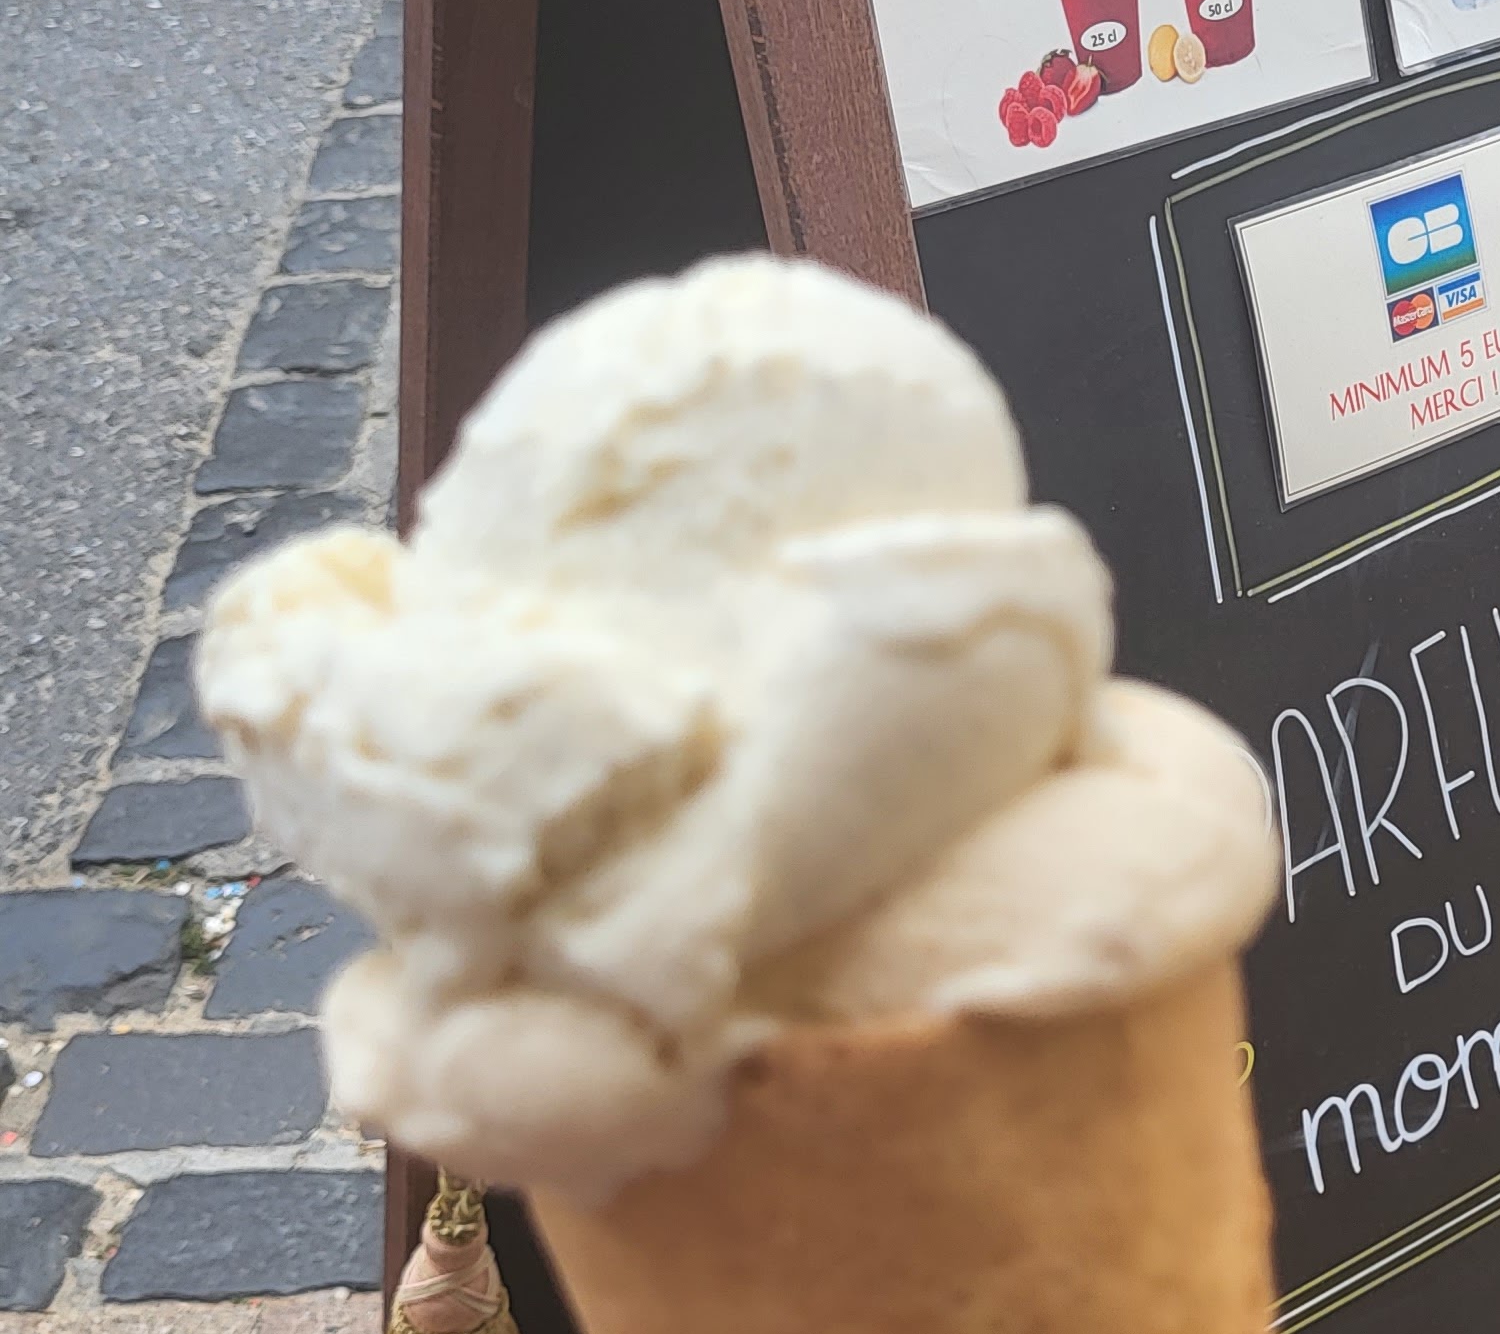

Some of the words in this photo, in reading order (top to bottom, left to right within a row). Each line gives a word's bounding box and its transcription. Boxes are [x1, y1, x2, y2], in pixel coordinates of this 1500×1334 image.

[1208, 3, 1222, 18] 50
[1090, 32, 1105, 48] 25
[1387, 203, 1464, 265] CB
[1445, 284, 1478, 309] VISA
[1329, 349, 1450, 422] MINIMUM
[1460, 340, 1474, 368] 5
[1410, 376, 1485, 431] MERCI
[1391, 884, 1492, 993] DU
